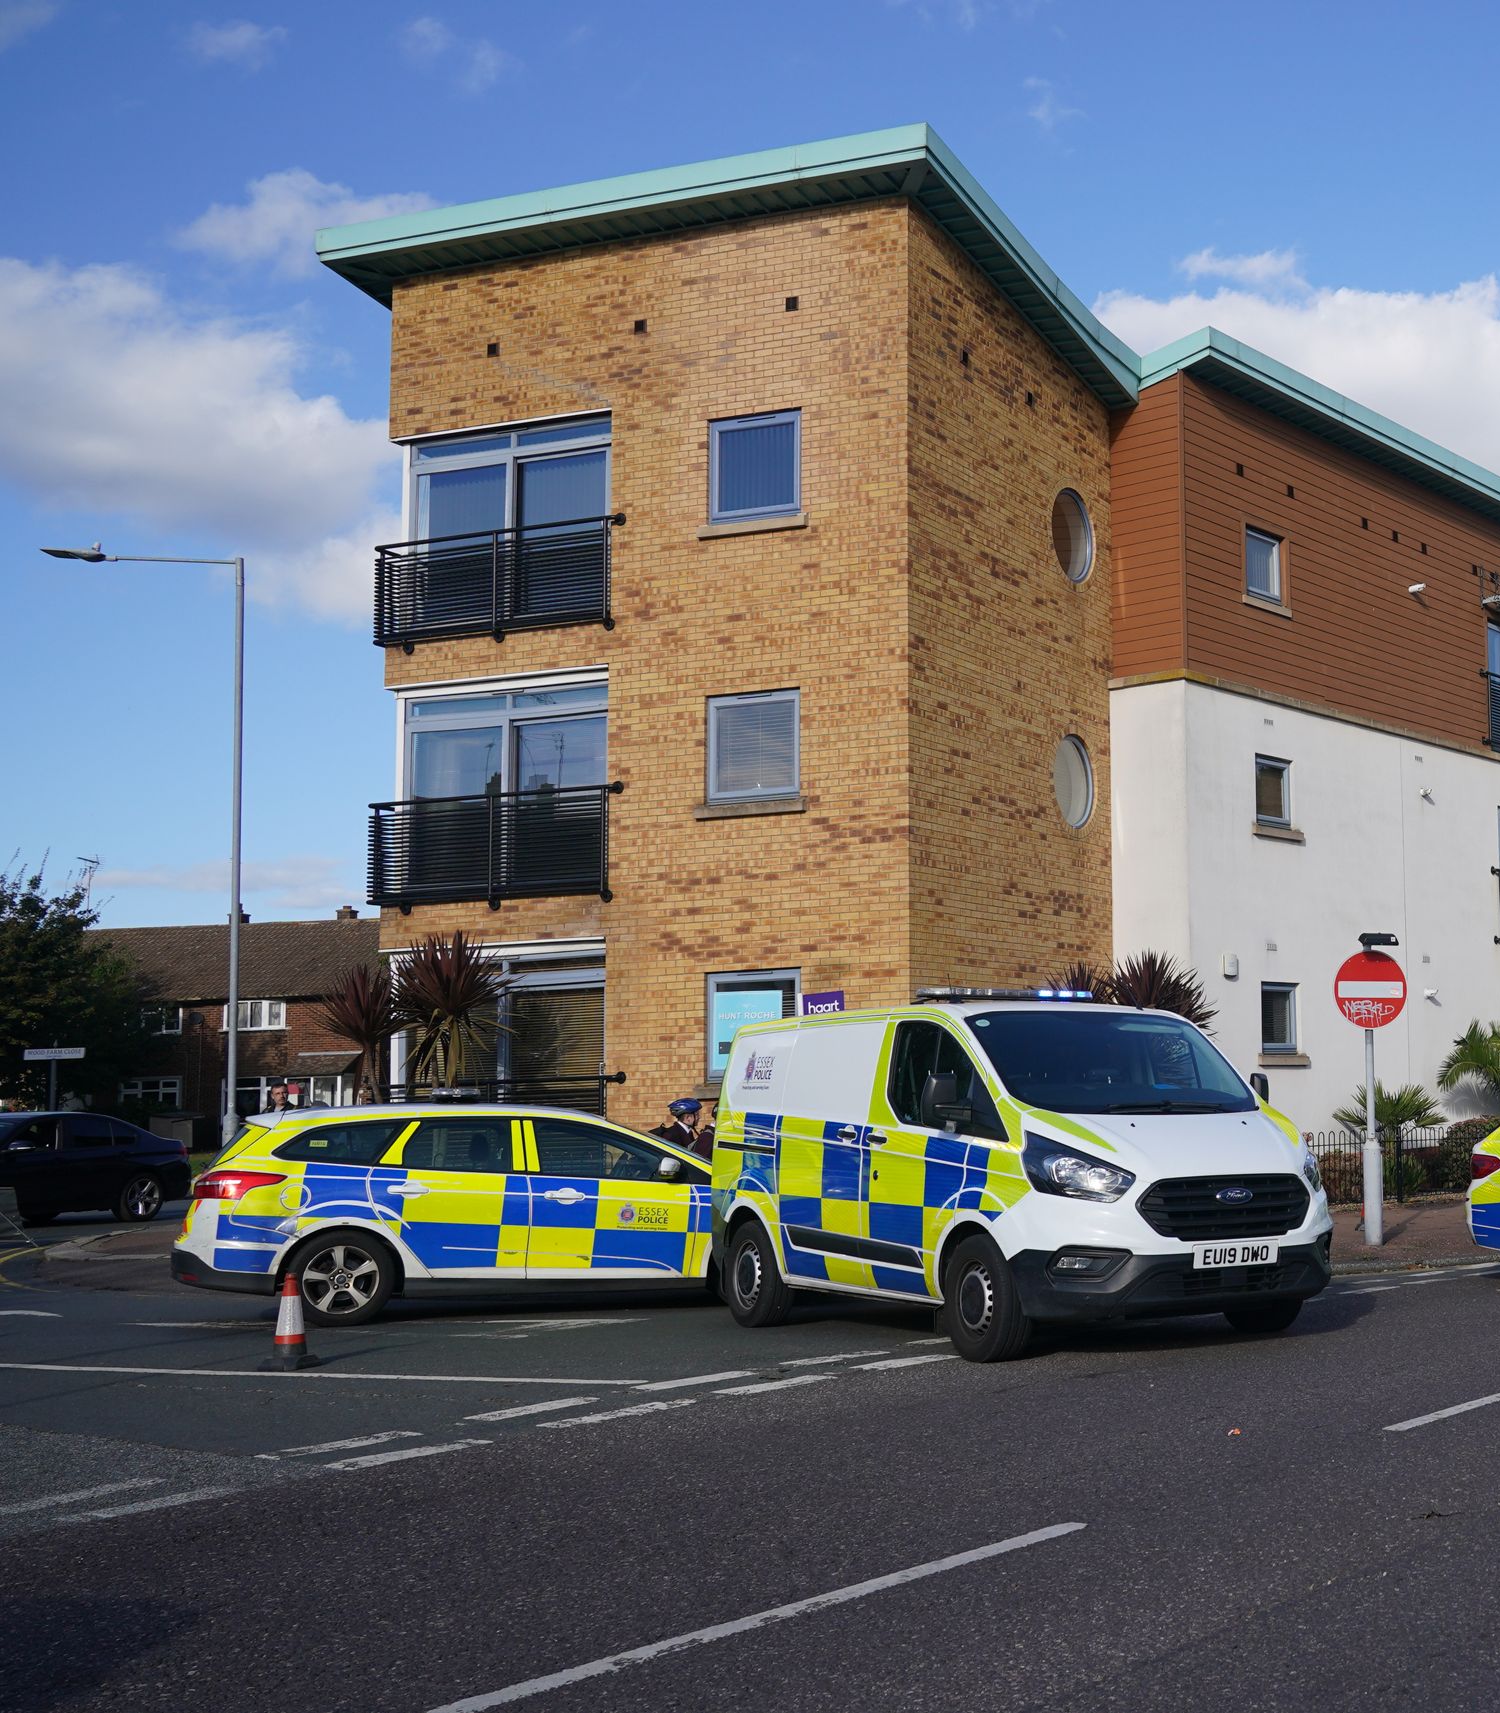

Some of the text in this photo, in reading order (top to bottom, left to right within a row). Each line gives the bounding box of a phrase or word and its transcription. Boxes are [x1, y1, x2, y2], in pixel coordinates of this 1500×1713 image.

[808, 1000, 840, 1014] haart
[719, 1011, 776, 1020] HUNT ROCHE
[756, 1056, 776, 1068] ESSEX
[754, 1070, 773, 1080] POLICE
[1225, 1190, 1246, 1199] Ford
[638, 1206, 669, 1217] ESSEX
[637, 1215, 669, 1225] POLICE
[1202, 1245, 1269, 1266] EU19 DWO
